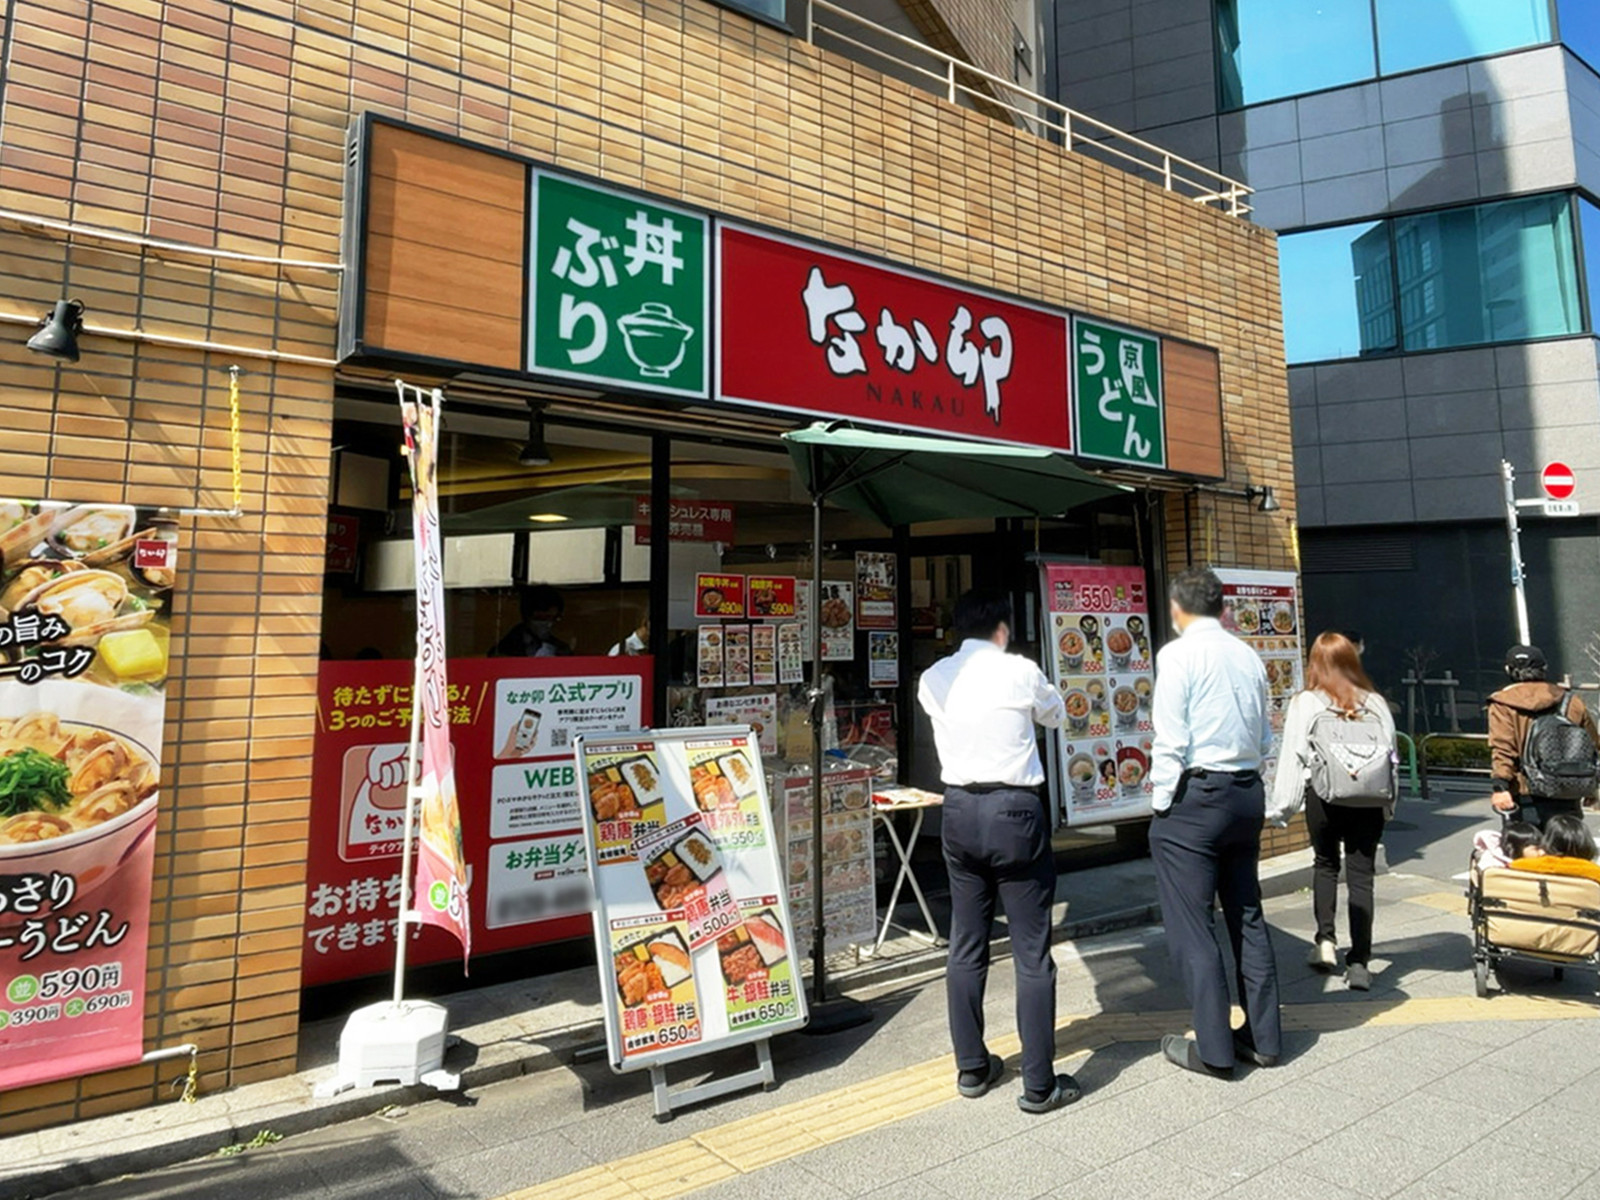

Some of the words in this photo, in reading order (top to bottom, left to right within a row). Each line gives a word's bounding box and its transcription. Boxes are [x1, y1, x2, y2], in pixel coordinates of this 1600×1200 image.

[802, 265, 1013, 424] なか卯
[1121, 342, 1149, 403] 京風
[865, 382, 966, 417] NAKAU
[1080, 329, 1152, 458] うどん
[333, 684, 471, 707] 待たずにる!
[506, 689, 546, 705] なか卯
[548, 681, 634, 703] 公式アプリ
[523, 766, 576, 789] WEB
[41, 964, 120, 999] 590円
[86, 993, 131, 1012] 690円
